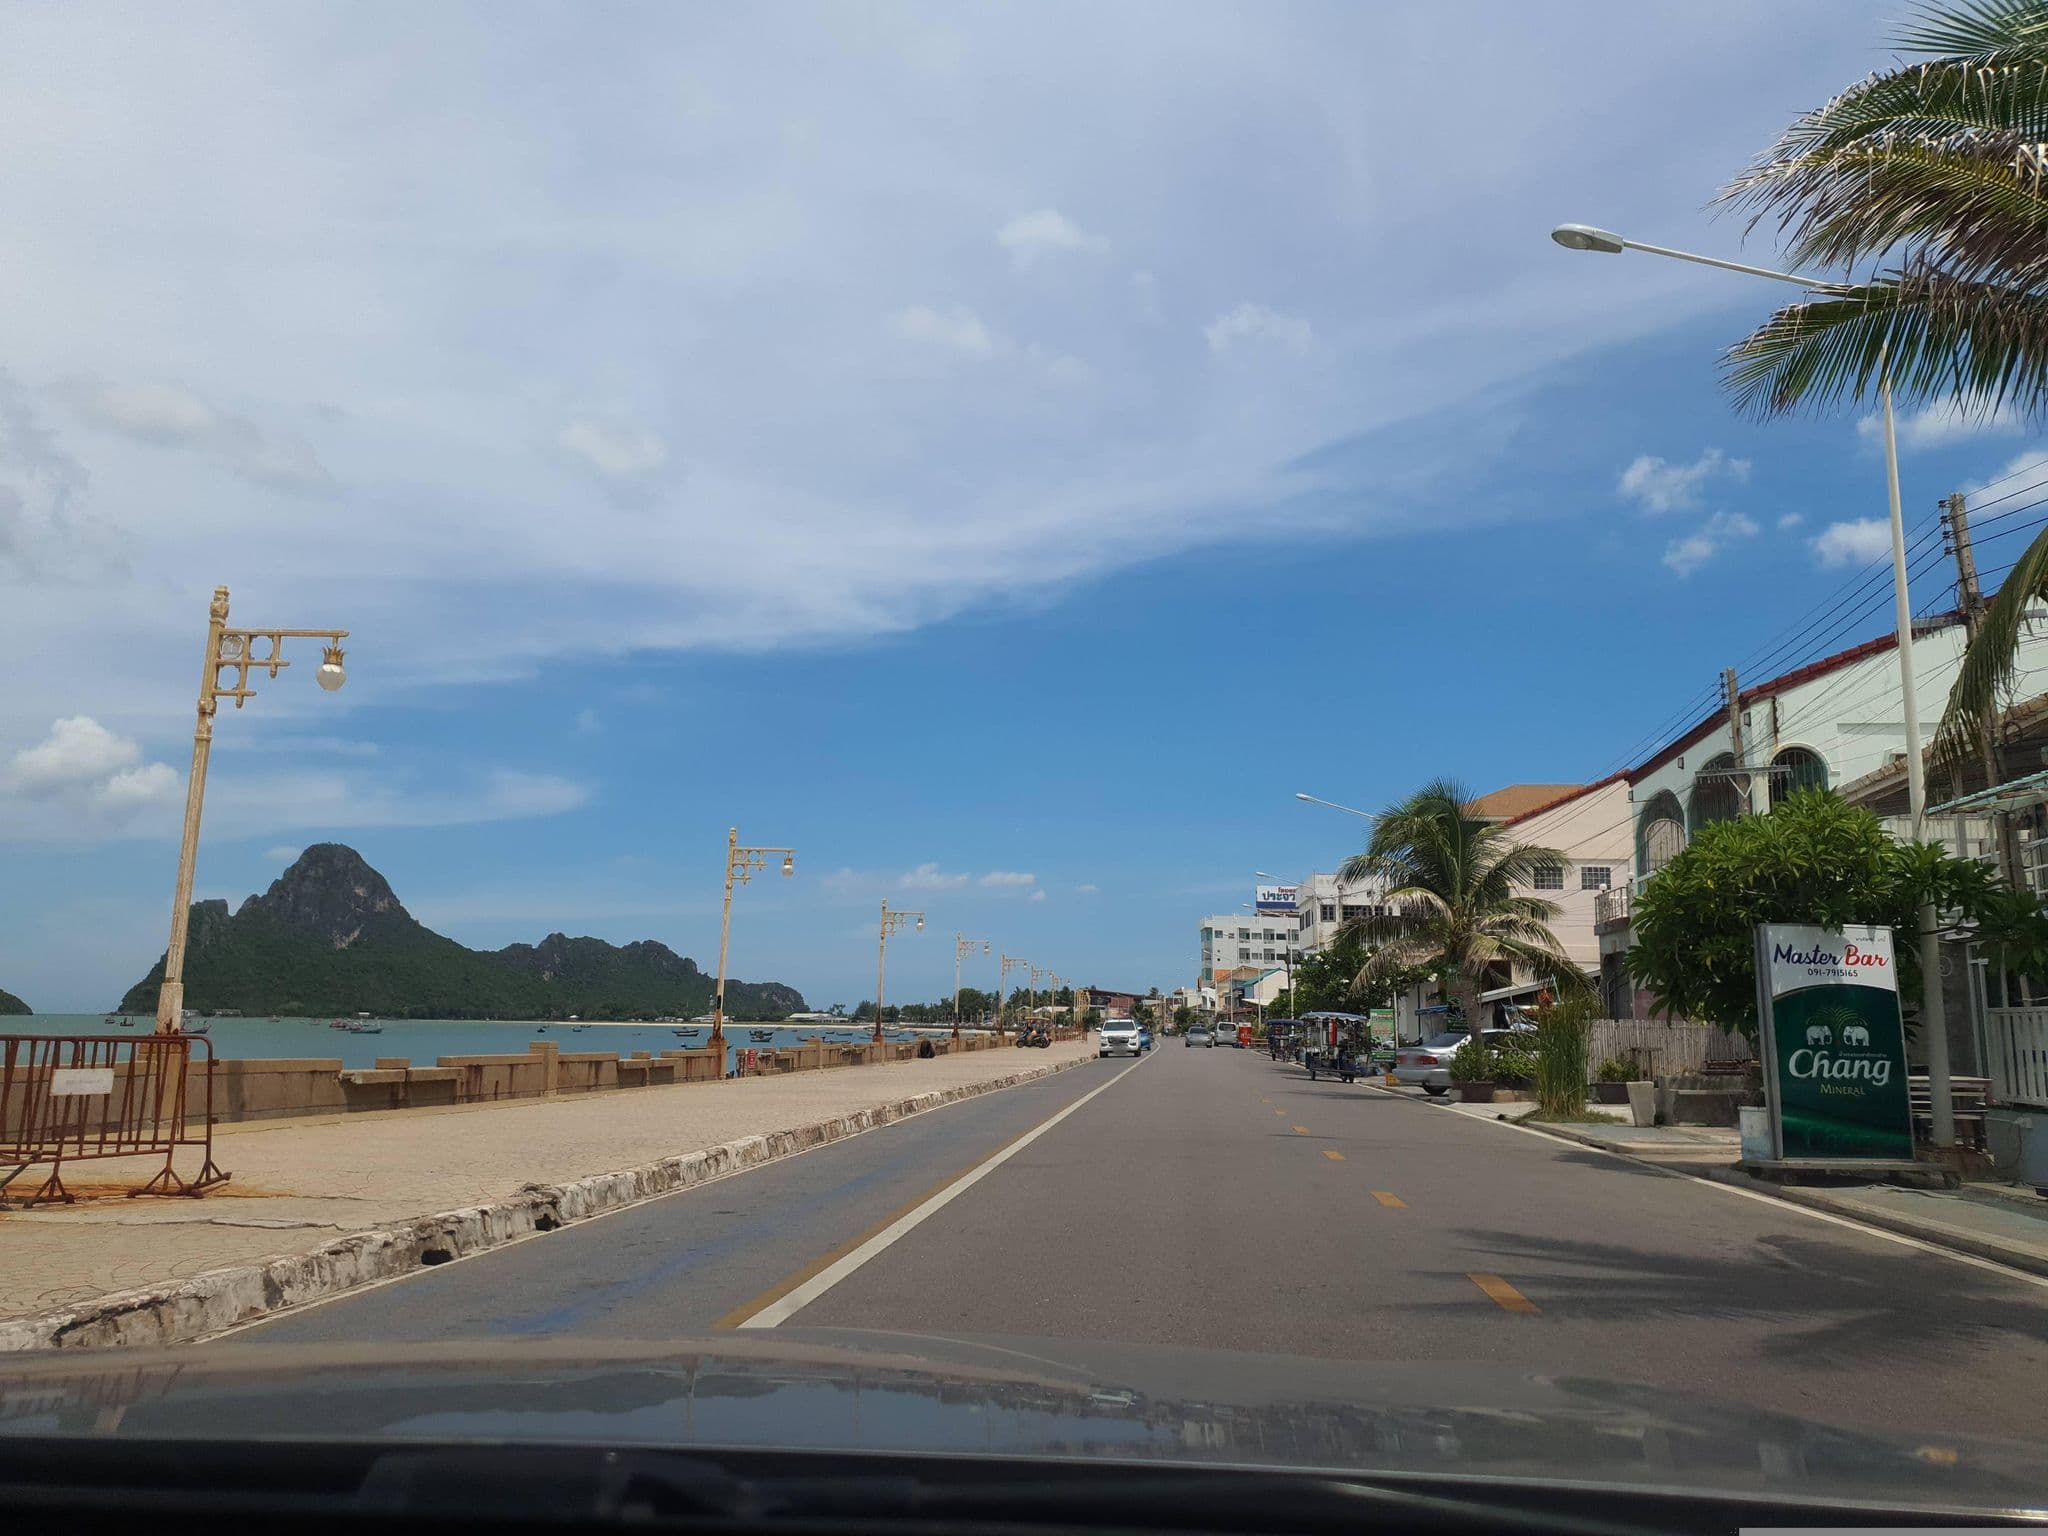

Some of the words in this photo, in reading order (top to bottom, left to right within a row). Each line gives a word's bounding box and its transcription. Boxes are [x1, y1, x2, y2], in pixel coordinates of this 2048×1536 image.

[1774, 944, 1842, 964] Master
[1845, 944, 1889, 967] Bar
[1808, 968, 1858, 977] 091-7915165
[1789, 1049, 1891, 1086] Chang
